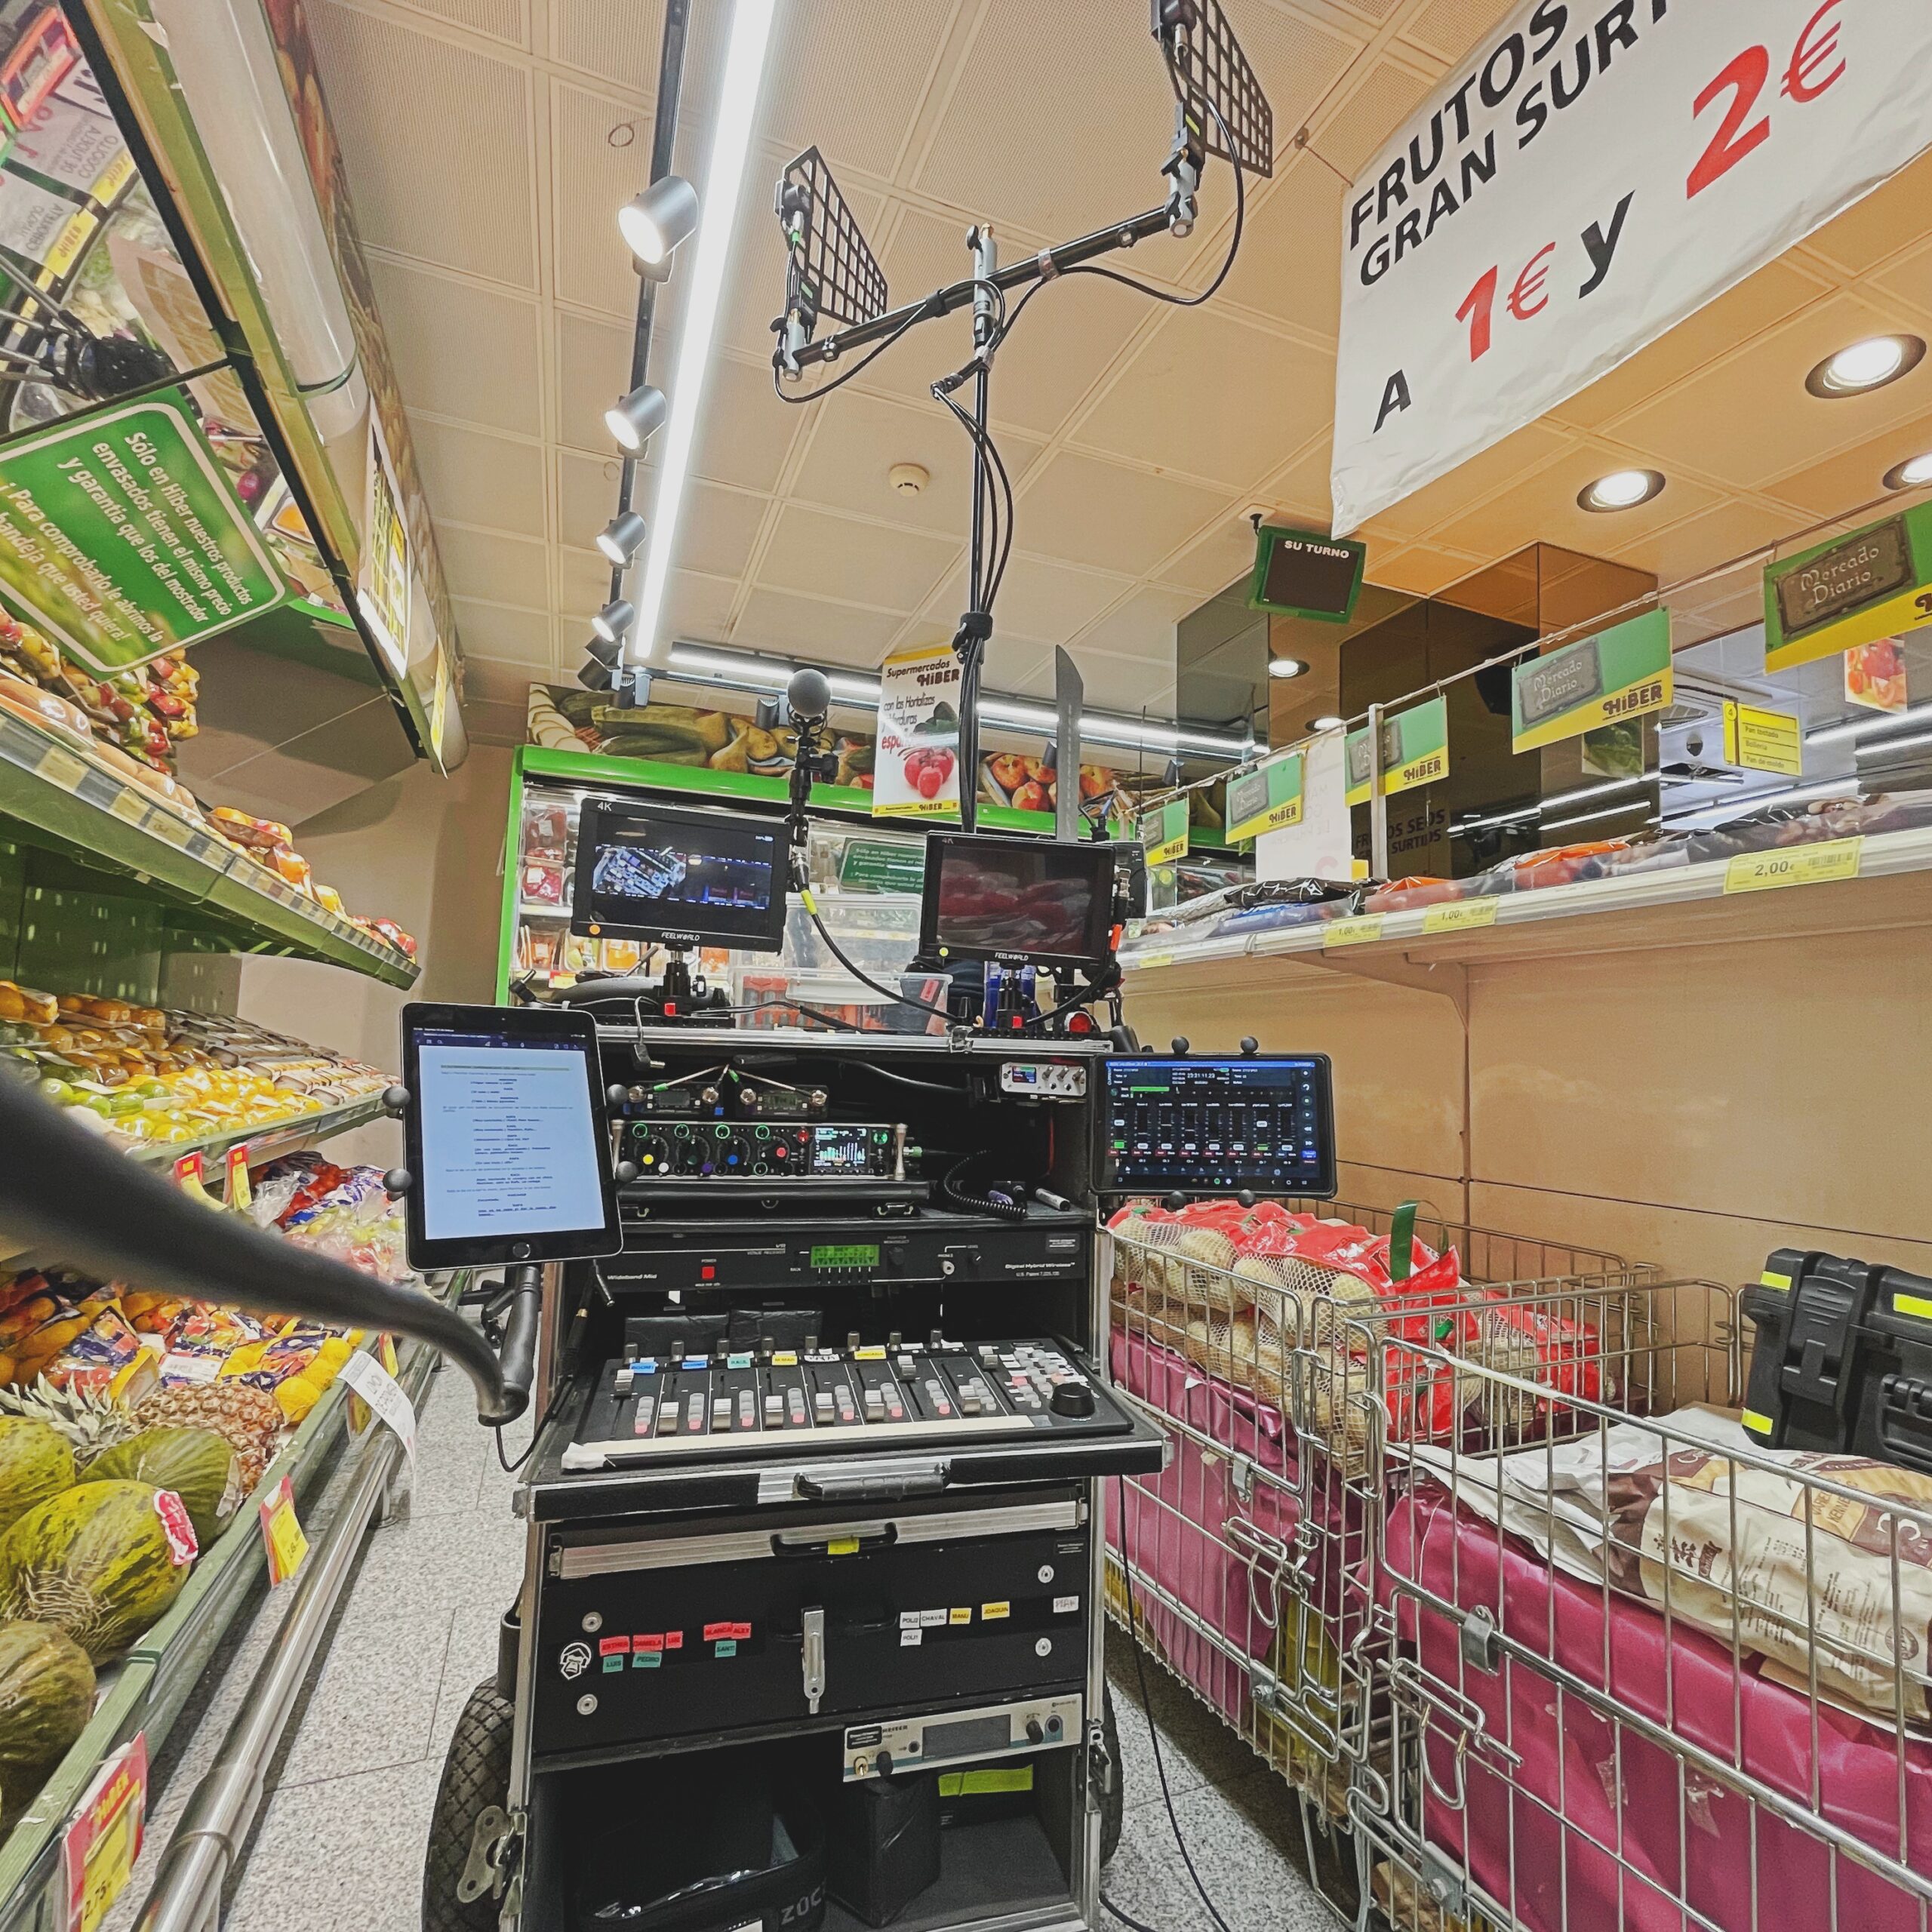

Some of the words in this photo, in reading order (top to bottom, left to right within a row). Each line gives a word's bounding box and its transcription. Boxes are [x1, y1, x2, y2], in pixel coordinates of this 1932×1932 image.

[1350, 0, 1568, 251] FRUTOS
[1360, 129, 1497, 286] GRAN
[1371, 368, 1412, 434] A
[1579, 189, 1635, 300] y
[92, 441, 154, 512] envasados
[125, 432, 157, 466] Sólo
[148, 466, 171, 486] en
[161, 482, 194, 518] Hiber
[183, 515, 225, 563] nuestros
[217, 559, 254, 606] productos
[144, 509, 180, 549] tienen
[57, 456, 85, 470] y
[116, 523, 146, 547] que
[137, 543, 160, 564] los
[151, 561, 179, 581] del
[165, 577, 210, 623] mostrador
[173, 544, 189, 559] el
[1284, 540, 1303, 552] SU
[1306, 543, 1350, 559] TURNO
[38, 521, 112, 592] comprobarlo
[108, 586, 123, 601] le
[117, 596, 156, 637] abrimos
[150, 629, 165, 644] la
[180, 555, 214, 591] mismo
[1801, 546, 1880, 592] Mercado
[1812, 571, 1872, 605] Diario
[36, 561, 69, 586] que
[61, 578, 102, 613] usted
[88, 606, 132, 642] quiera!
[201, 586, 233, 617] precio
[886, 660, 951, 678] Supermercados
[1534, 659, 1583, 691] Mercado
[1540, 678, 1577, 703] Diario
[597, 801, 612, 812] 4K
